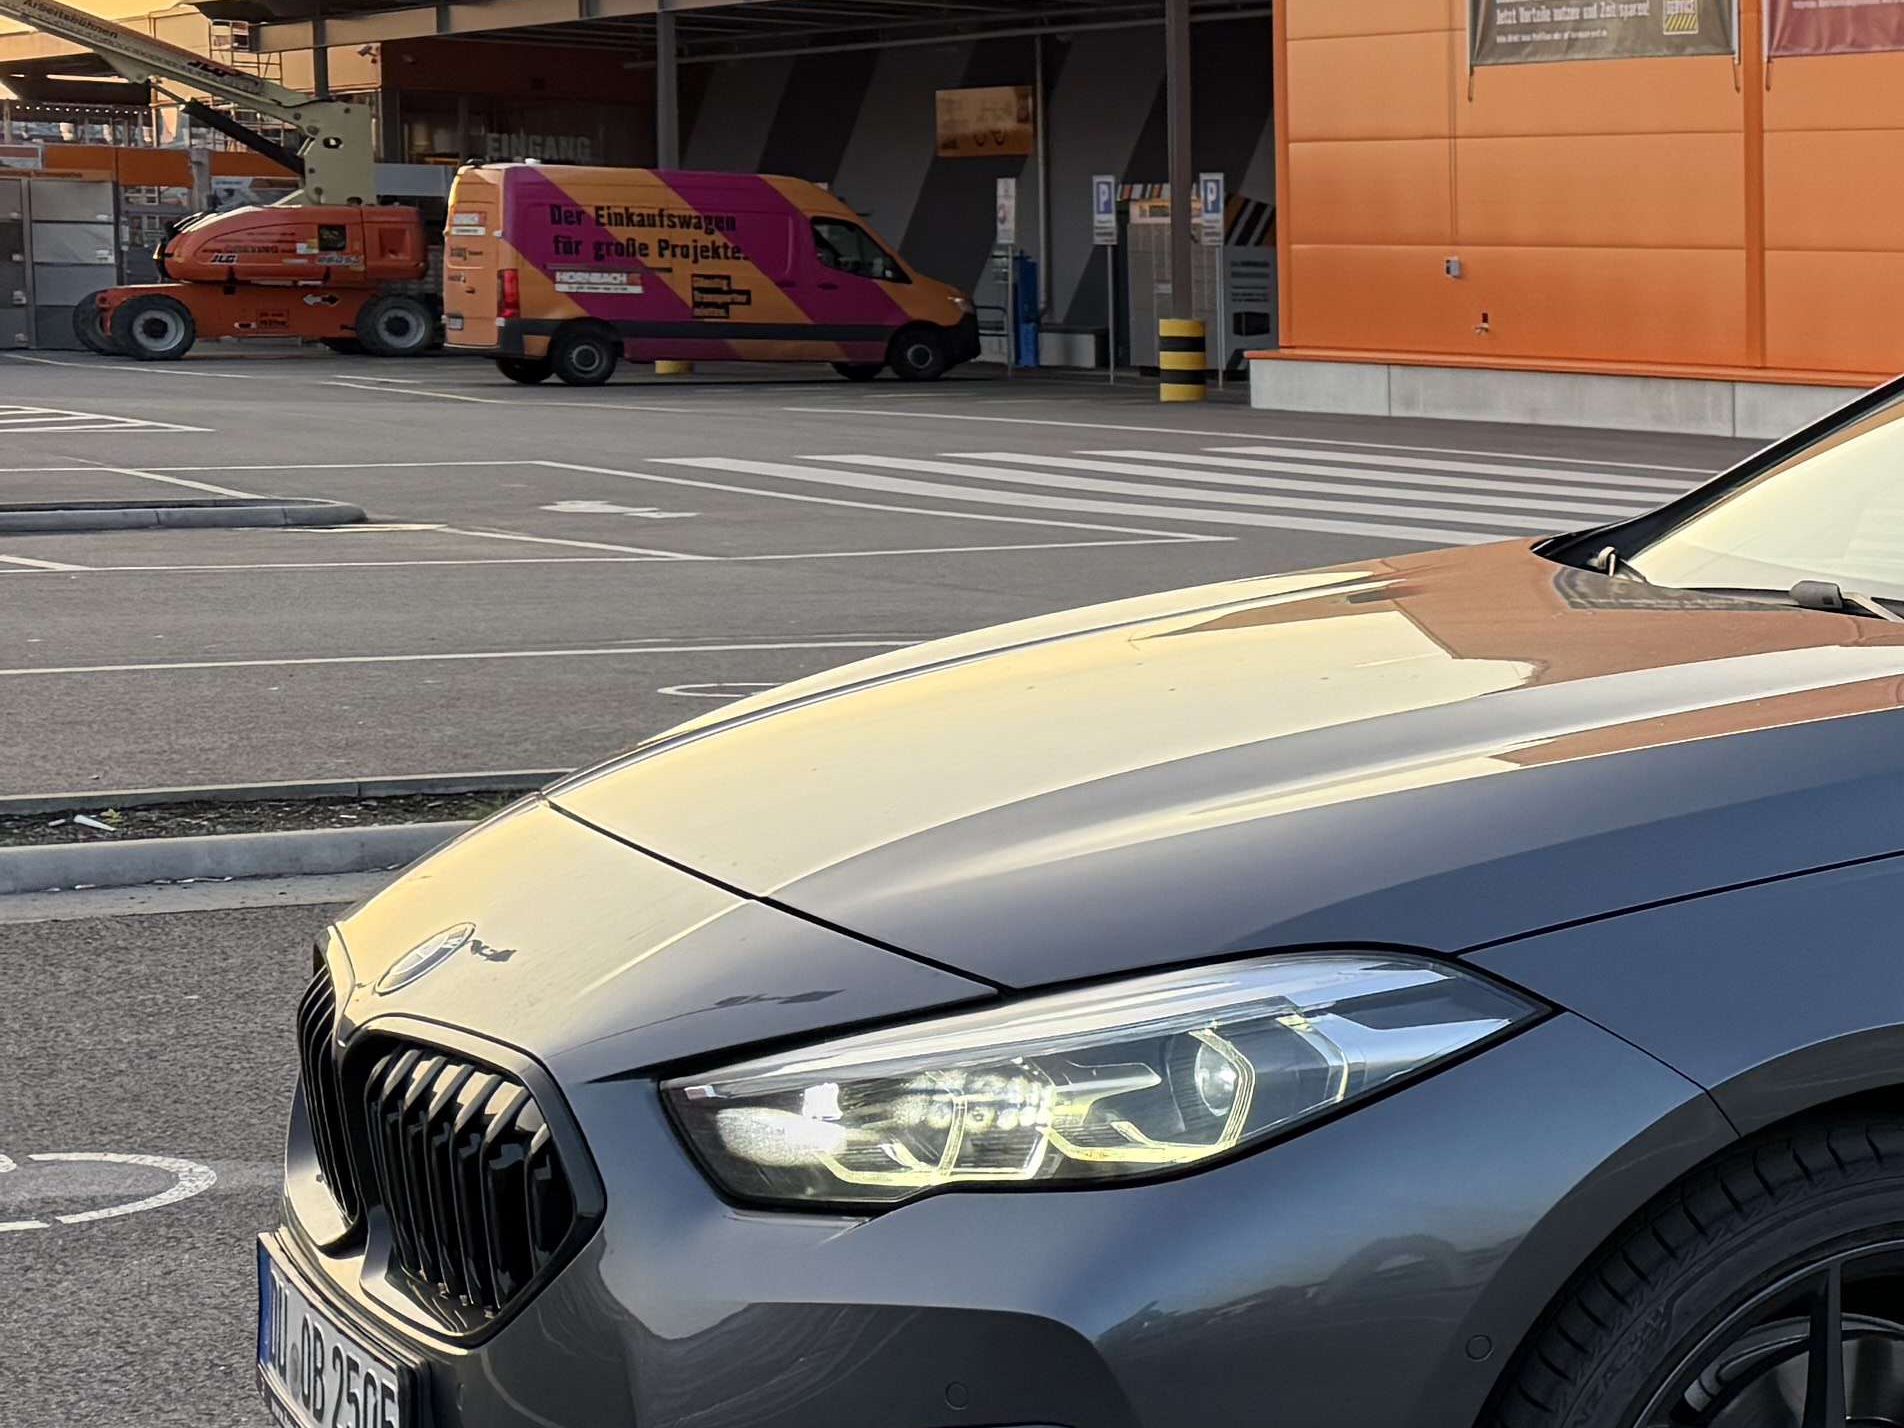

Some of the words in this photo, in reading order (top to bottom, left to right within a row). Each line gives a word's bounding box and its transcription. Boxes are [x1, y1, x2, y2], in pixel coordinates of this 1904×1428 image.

[486, 133, 592, 160] EINGANG
[549, 203, 586, 227] Der
[594, 205, 737, 235] Einkaufswagen
[210, 253, 237, 264] JLG
[553, 234, 583, 257] für
[593, 237, 650, 262] große
[657, 239, 752, 264] Projekte.
[555, 271, 628, 284] HORNBACH
